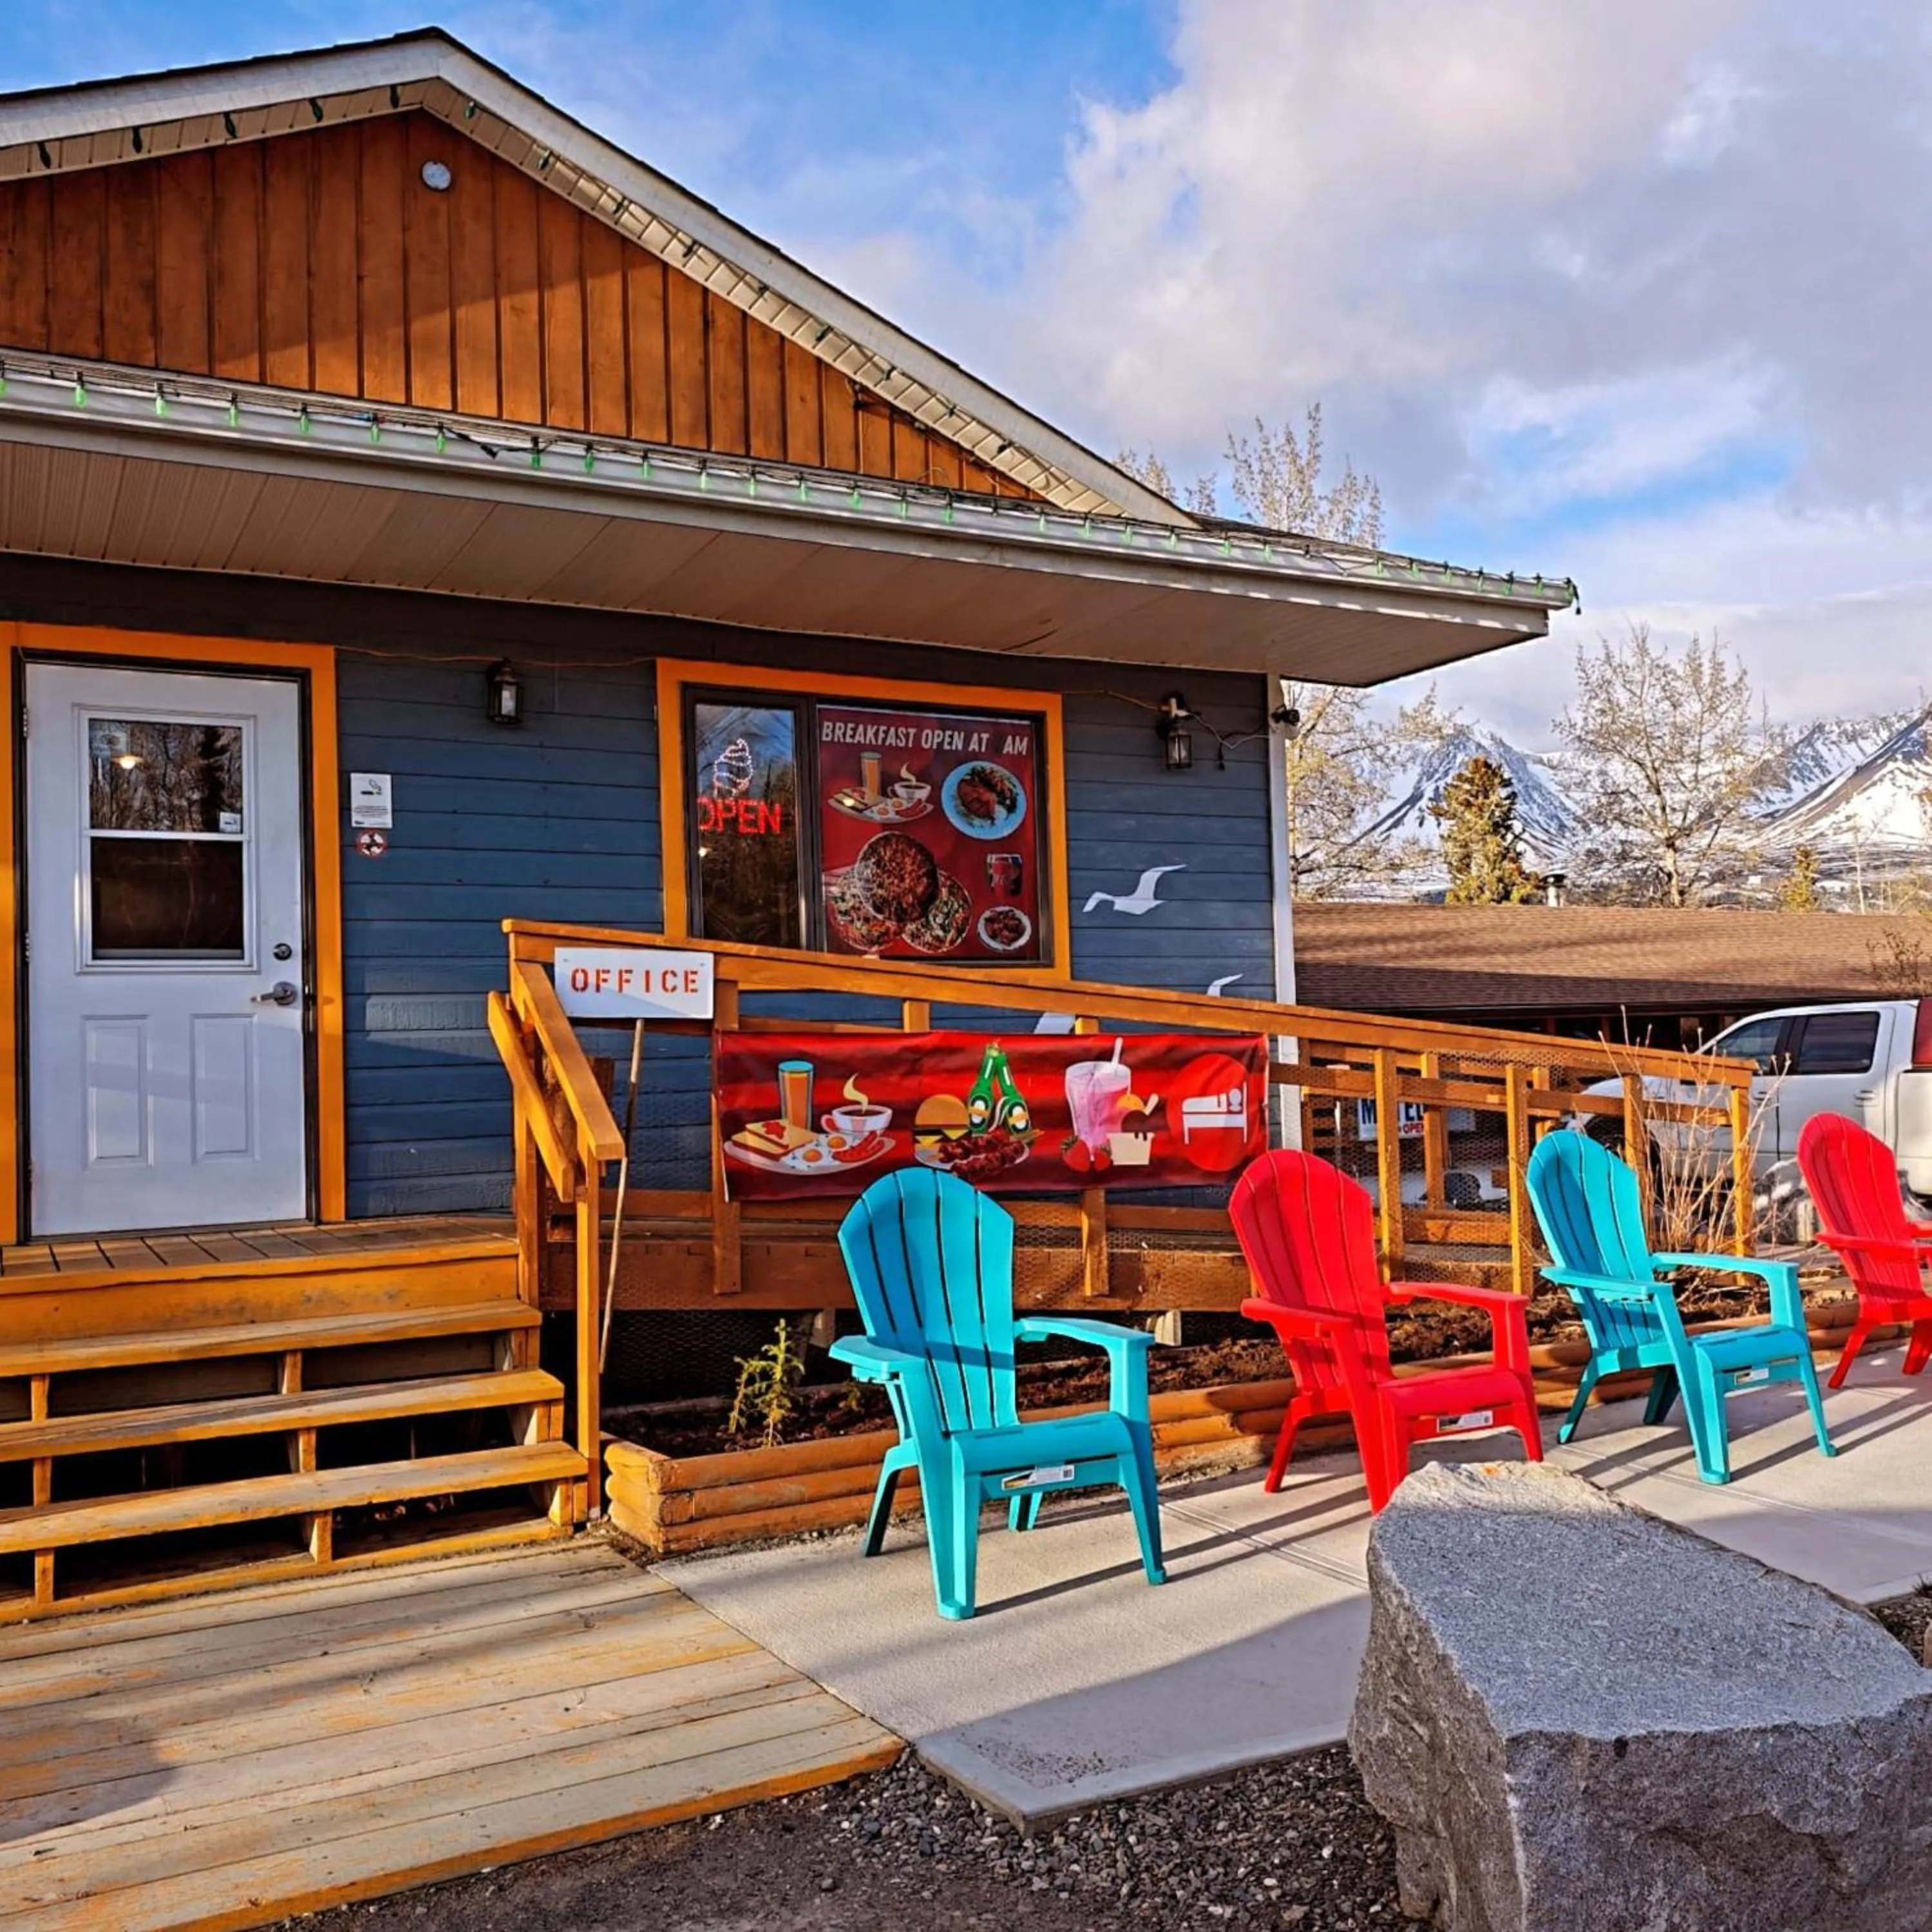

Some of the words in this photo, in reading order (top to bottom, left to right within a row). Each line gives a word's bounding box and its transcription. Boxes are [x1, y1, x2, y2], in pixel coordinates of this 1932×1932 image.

[822, 721, 917, 748] BREAKFAST
[921, 728, 965, 751] OPEN
[968, 732, 990, 753] AT
[1002, 735, 1028, 755] AM
[697, 796, 782, 834] OPEN
[571, 968, 699, 994] OFFICE
[1361, 1099, 1425, 1124] MEL
